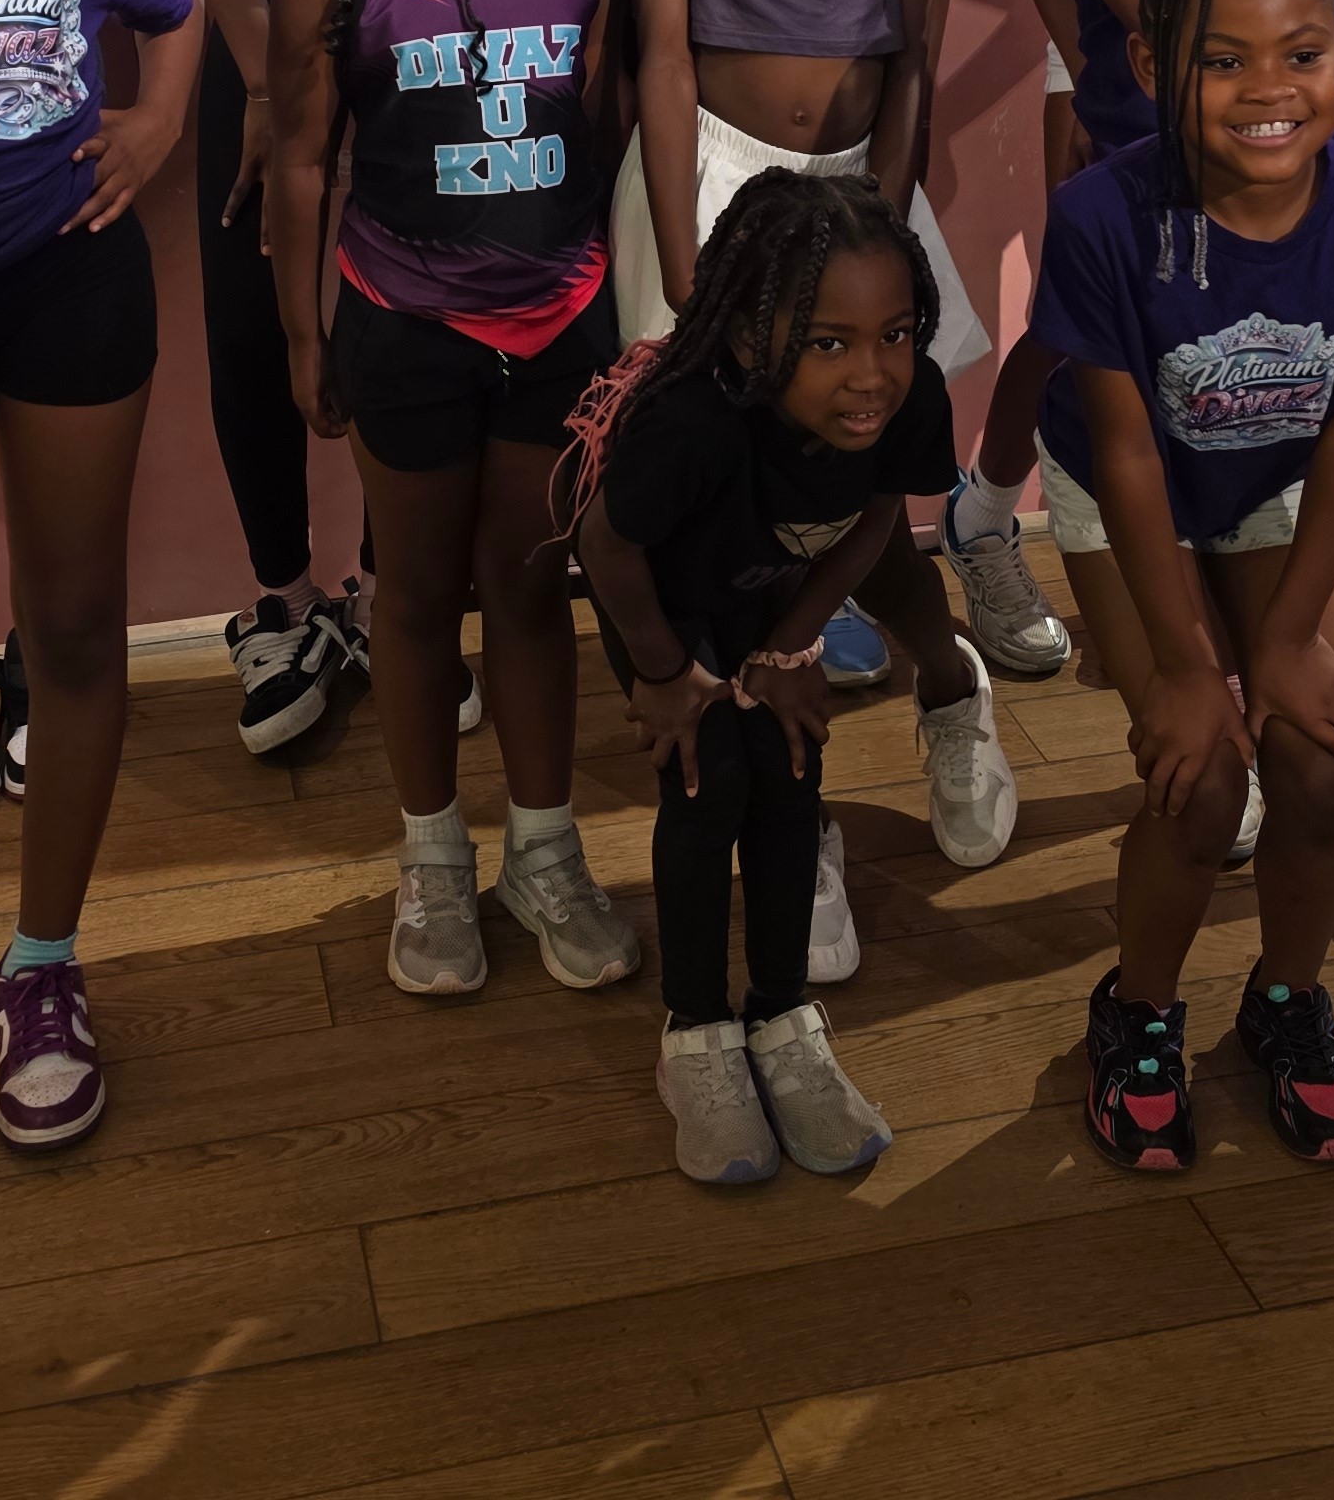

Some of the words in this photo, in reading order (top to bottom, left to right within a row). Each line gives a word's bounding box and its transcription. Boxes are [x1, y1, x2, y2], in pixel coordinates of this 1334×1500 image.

[389, 24, 581, 91] DIVAZ
[476, 83, 528, 139] U
[434, 133, 566, 196] KNO
[1185, 355, 1327, 396] Platinum
[1184, 381, 1326, 427] Divaz
